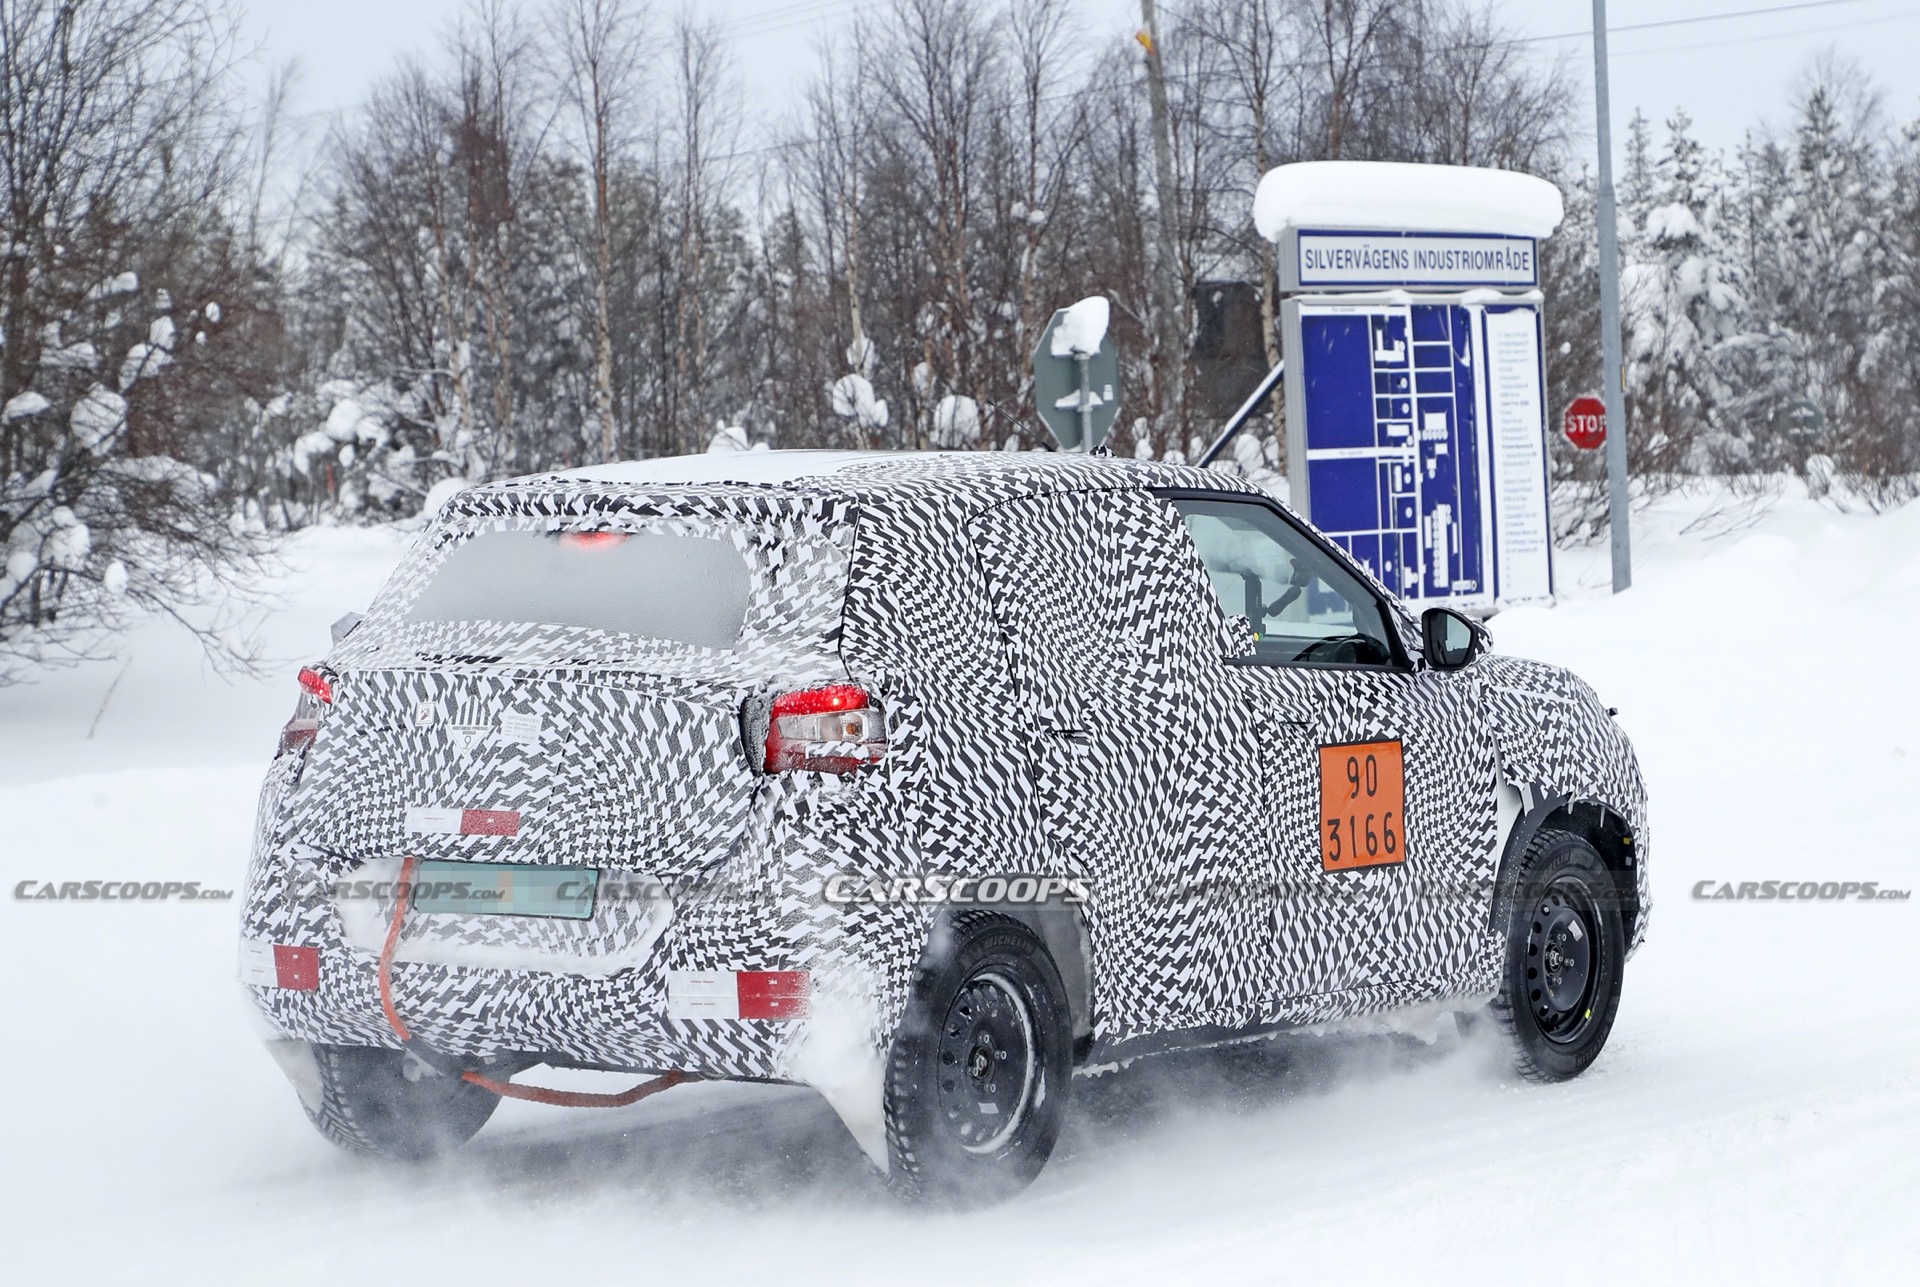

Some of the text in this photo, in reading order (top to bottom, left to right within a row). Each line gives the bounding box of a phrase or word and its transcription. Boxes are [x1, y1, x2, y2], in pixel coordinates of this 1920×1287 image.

[1305, 244, 1530, 271] SILVERVÄGENS INDUSTRIOMRÅDE
[1347, 754, 1378, 799] 90
[1327, 811, 1396, 861] 3166
